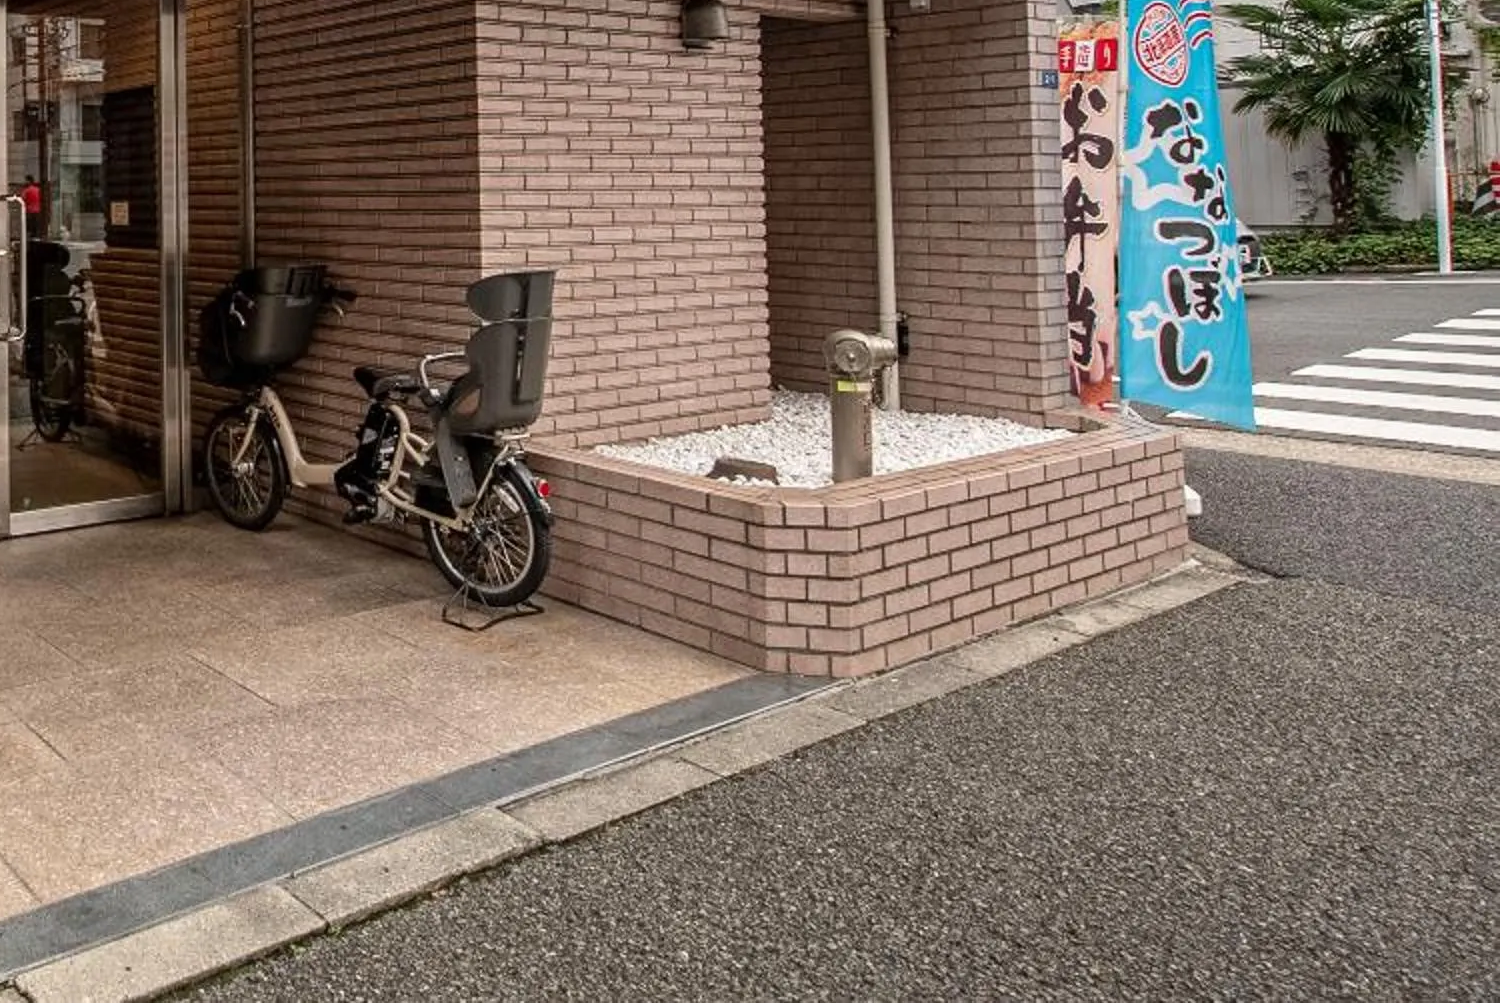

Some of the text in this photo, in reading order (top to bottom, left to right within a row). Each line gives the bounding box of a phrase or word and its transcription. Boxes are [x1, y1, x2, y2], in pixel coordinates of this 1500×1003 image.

[1147, 101, 1229, 387] ななつぼし
